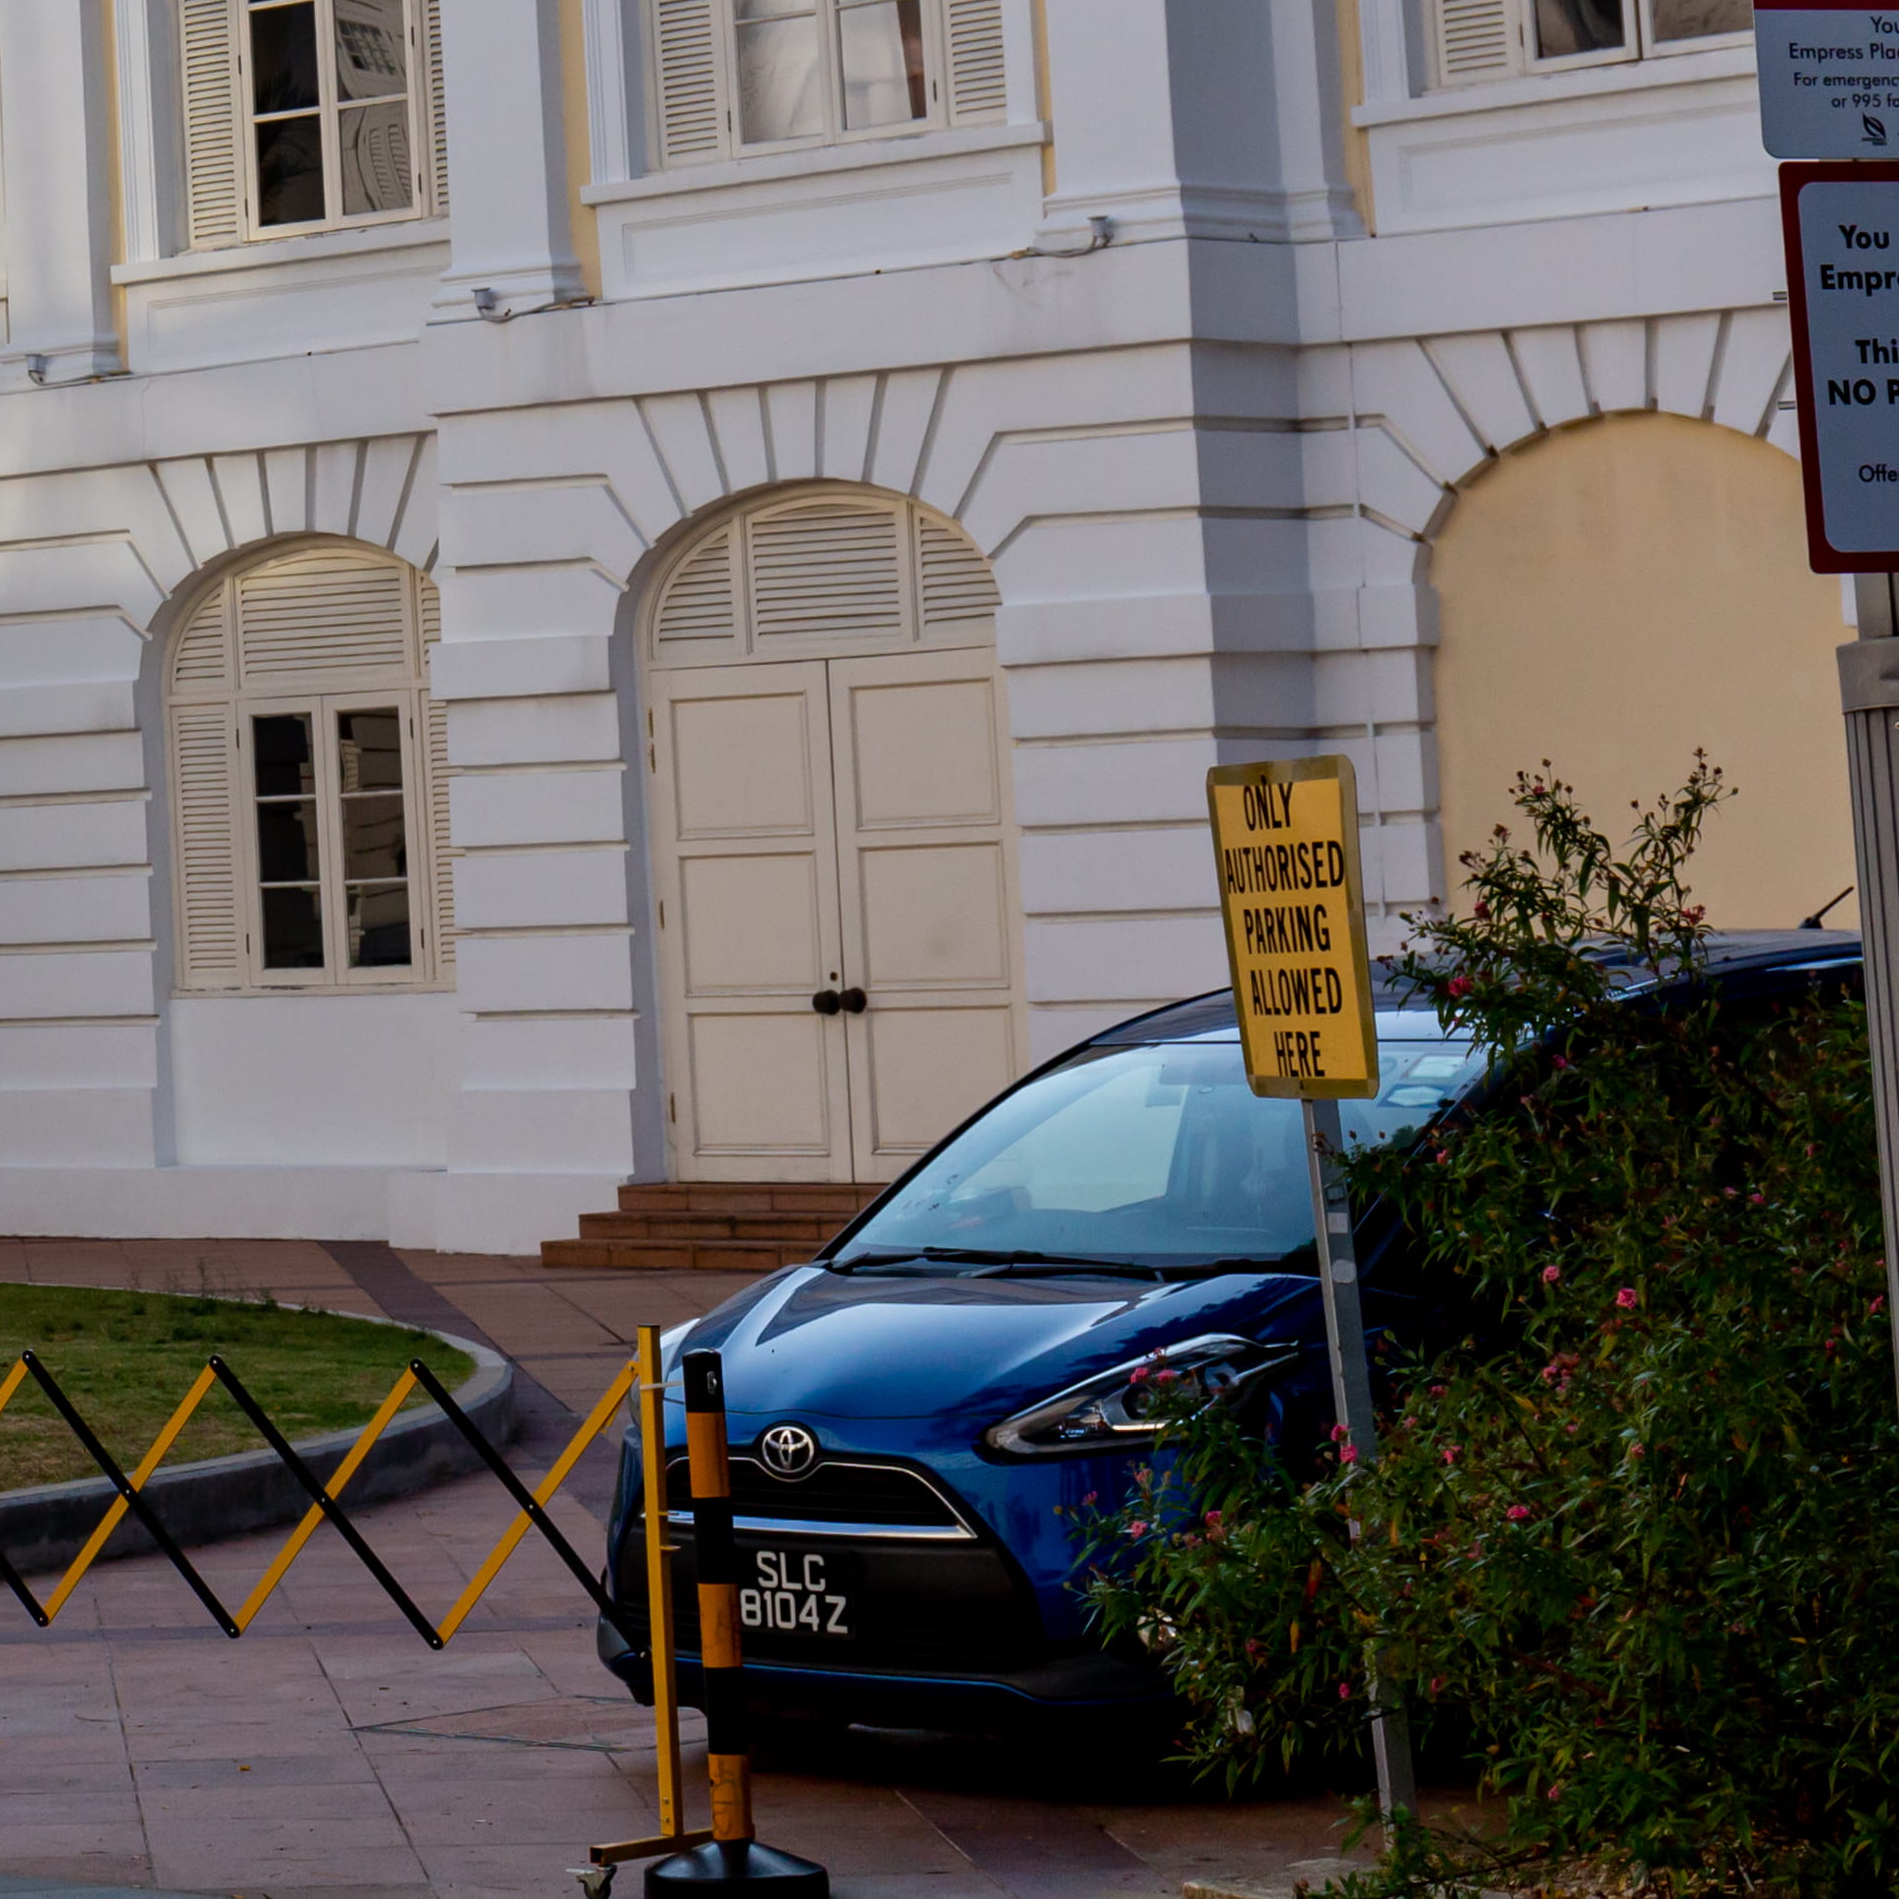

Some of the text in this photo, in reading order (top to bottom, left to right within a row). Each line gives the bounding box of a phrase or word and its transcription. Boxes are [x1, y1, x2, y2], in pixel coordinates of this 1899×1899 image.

[1789, 42, 1899, 64] Empress Pla
[1794, 72, 1819, 87] For
[1832, 97, 1847, 108] or
[1852, 93, 1882, 108] 995
[1838, 224, 1890, 249] You
[1820, 264, 1899, 297] Empr
[1827, 378, 1876, 406] NO
[1243, 782, 1294, 831] ONLY
[1225, 840, 1344, 894] AUTHORISED
[1244, 904, 1331, 955] PARKING
[1250, 967, 1343, 1016] ALLOWED
[1274, 1030, 1325, 1078] HERE
[756, 1551, 826, 1592] SLC
[740, 1588, 848, 1634] 8104Z
